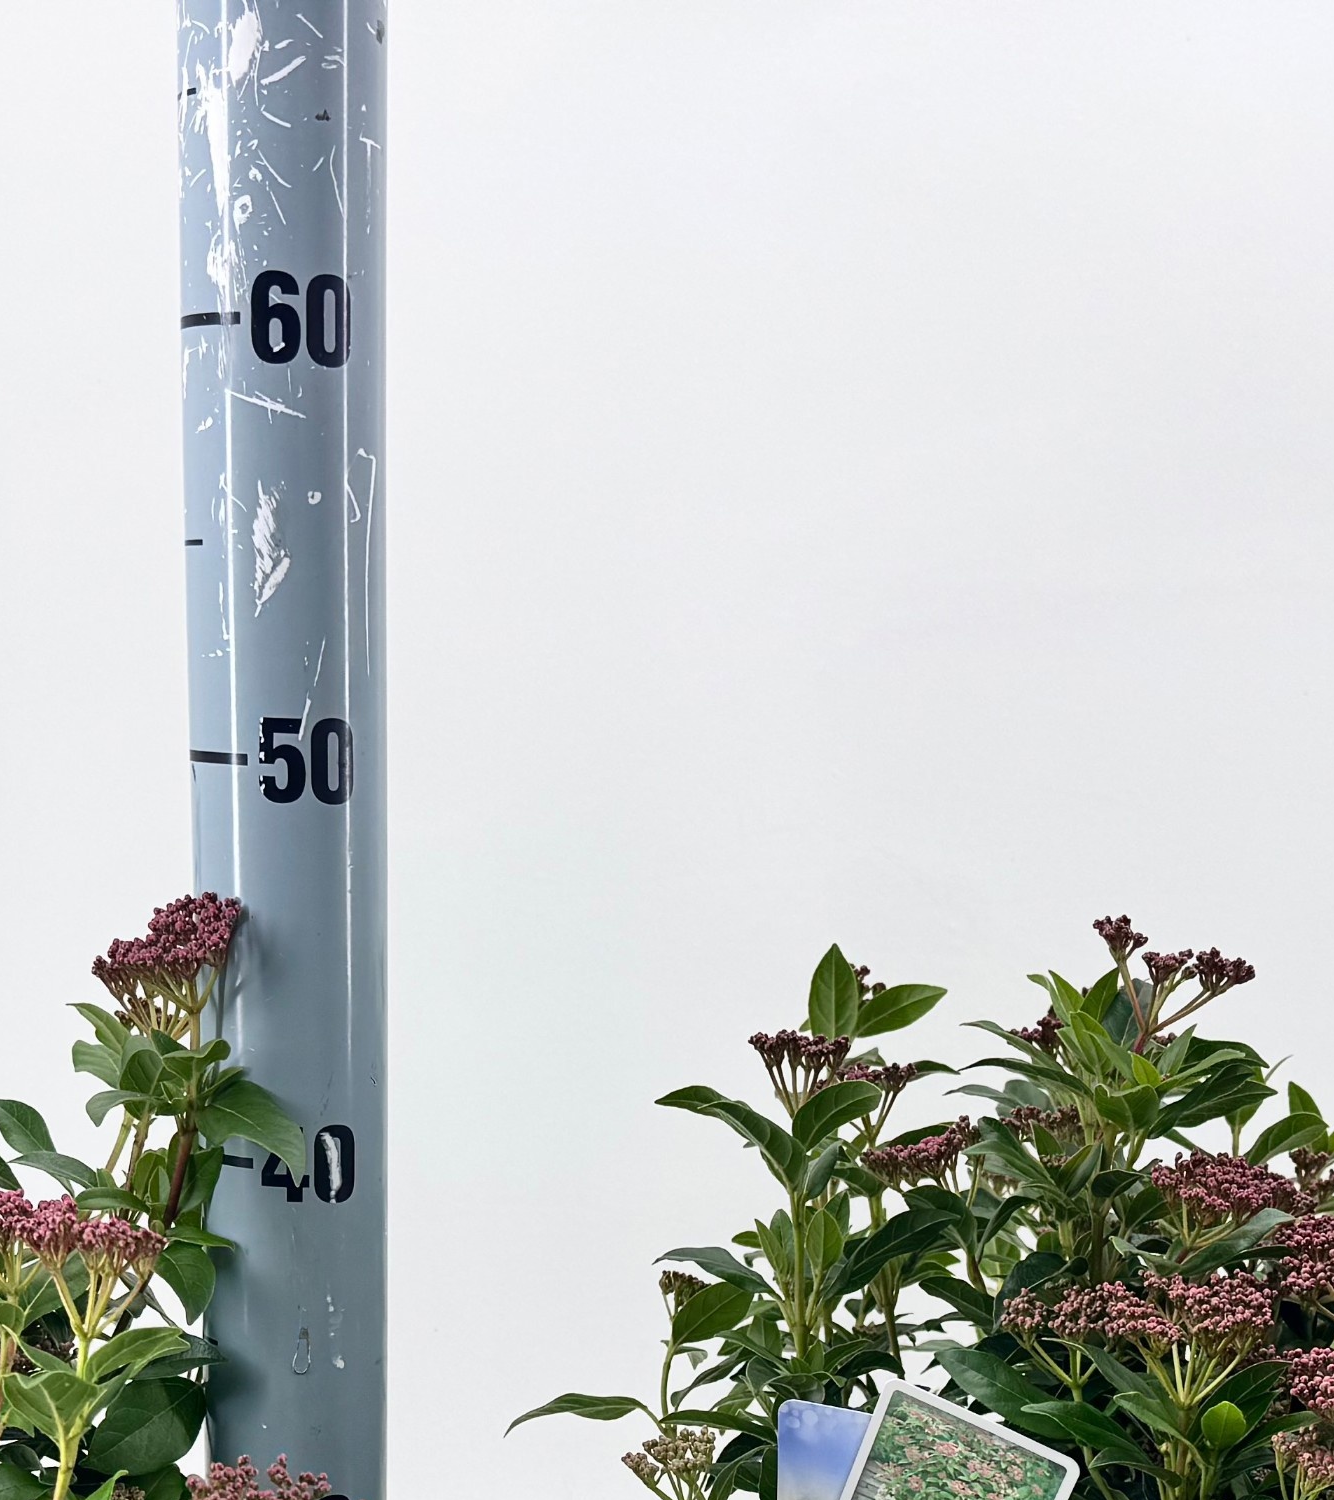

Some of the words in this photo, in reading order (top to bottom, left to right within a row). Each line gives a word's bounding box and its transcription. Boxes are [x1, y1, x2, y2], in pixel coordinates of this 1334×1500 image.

[249, 269, 352, 368] 60
[258, 716, 355, 805] 50
[260, 1124, 356, 1204] 40
